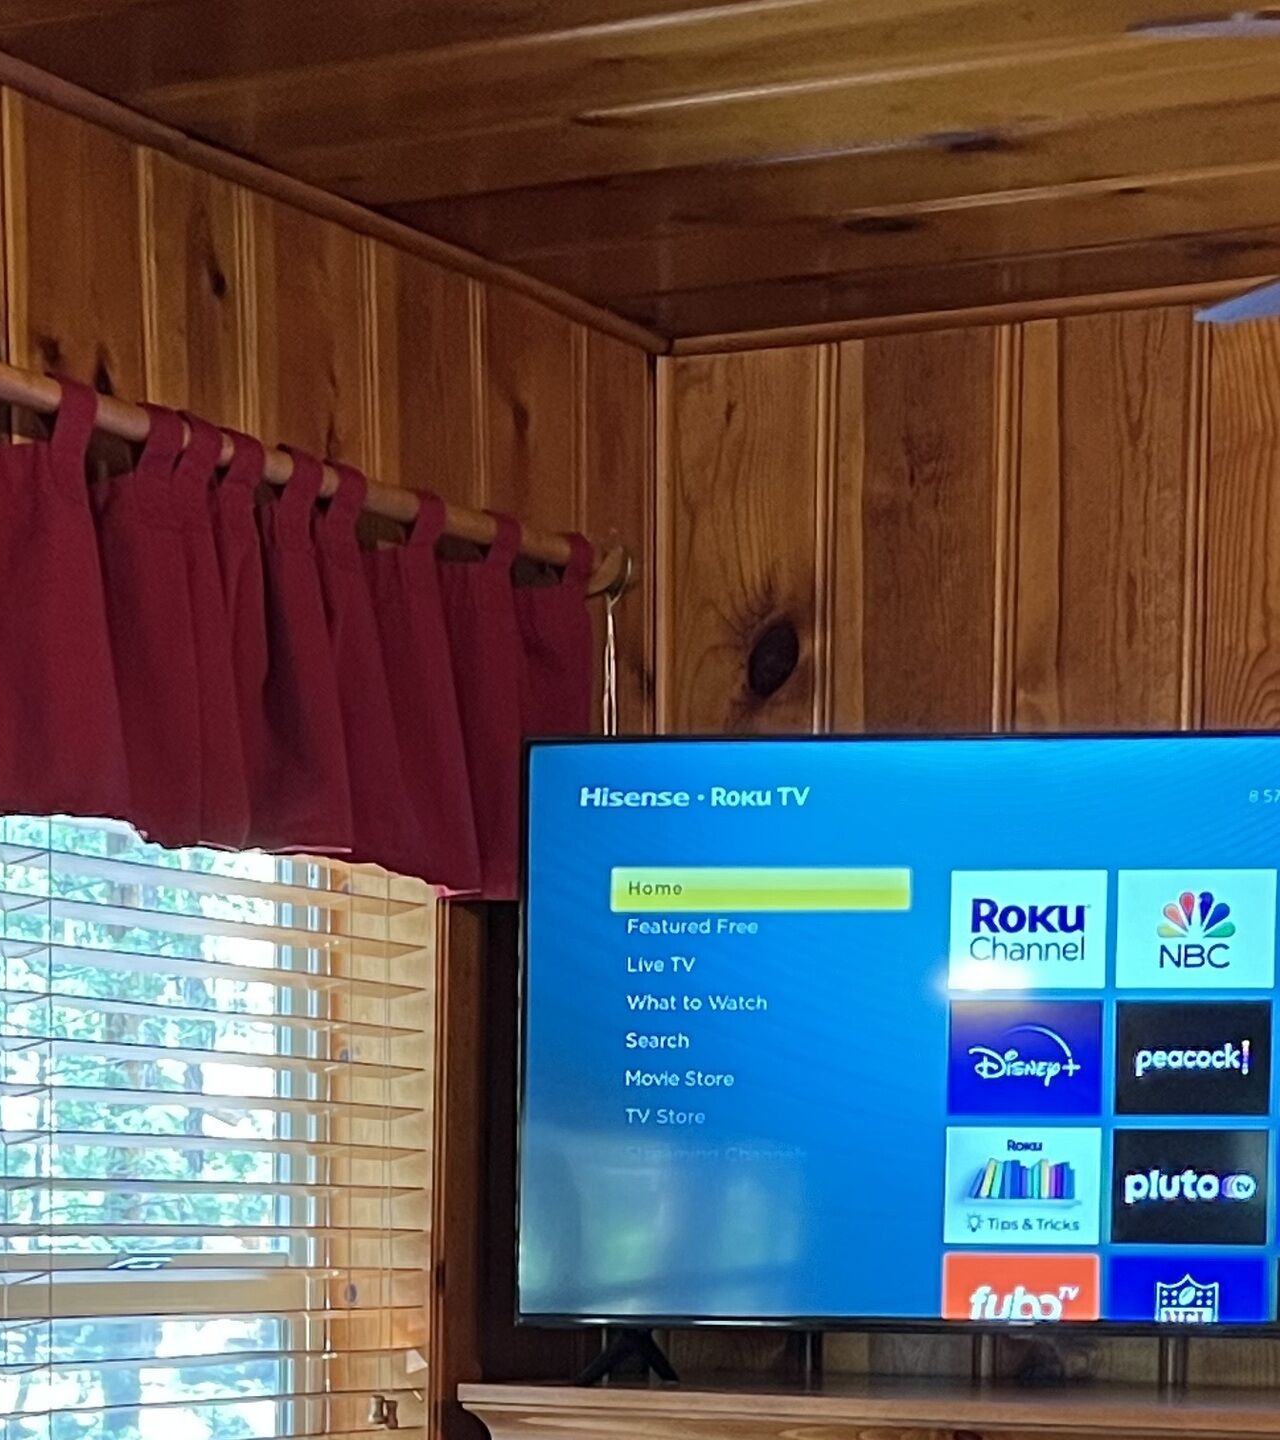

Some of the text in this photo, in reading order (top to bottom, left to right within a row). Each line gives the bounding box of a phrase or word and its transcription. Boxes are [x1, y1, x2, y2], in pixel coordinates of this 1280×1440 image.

[580, 786, 810, 807] Hisense Roku TV
[628, 881, 683, 896] Home
[970, 898, 1086, 933] Roku
[627, 918, 759, 934] Featured Free
[970, 936, 1085, 961] Channel
[1159, 943, 1230, 969] NBC
[627, 956, 696, 973] Live TV
[626, 995, 768, 1011] What to Watch
[625, 1032, 690, 1048] Search
[625, 1070, 735, 1087] Movie Store
[625, 1108, 706, 1125] TV Store
[1124, 1169, 1219, 1204] pluto
[987, 1217, 1080, 1231] Tips & Tricks
[969, 1285, 1081, 1320] fubo TV
